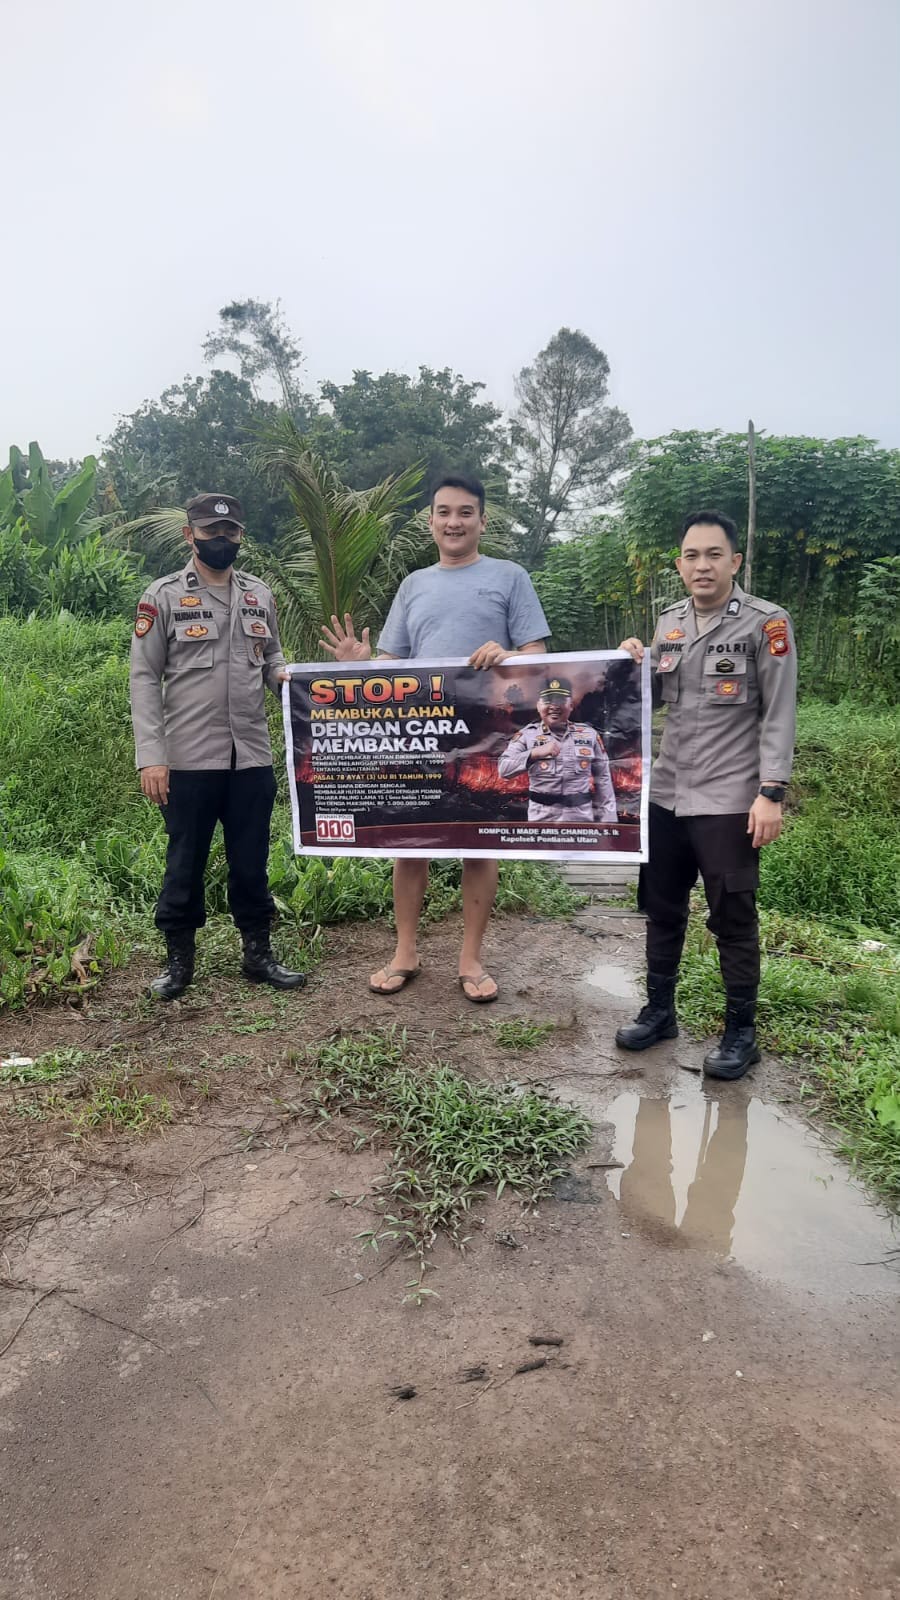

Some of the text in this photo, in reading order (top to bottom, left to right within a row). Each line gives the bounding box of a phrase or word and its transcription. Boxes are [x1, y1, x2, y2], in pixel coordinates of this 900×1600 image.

[708, 642, 746, 654] POLRI
[310, 674, 444, 704] STOP !
[310, 706, 454, 720] MEMBUKA LAHAN
[310, 720, 470, 738] DENGAN CARA
[312, 737, 438, 754] MEMBAKAR
[318, 822, 352, 836] 110
